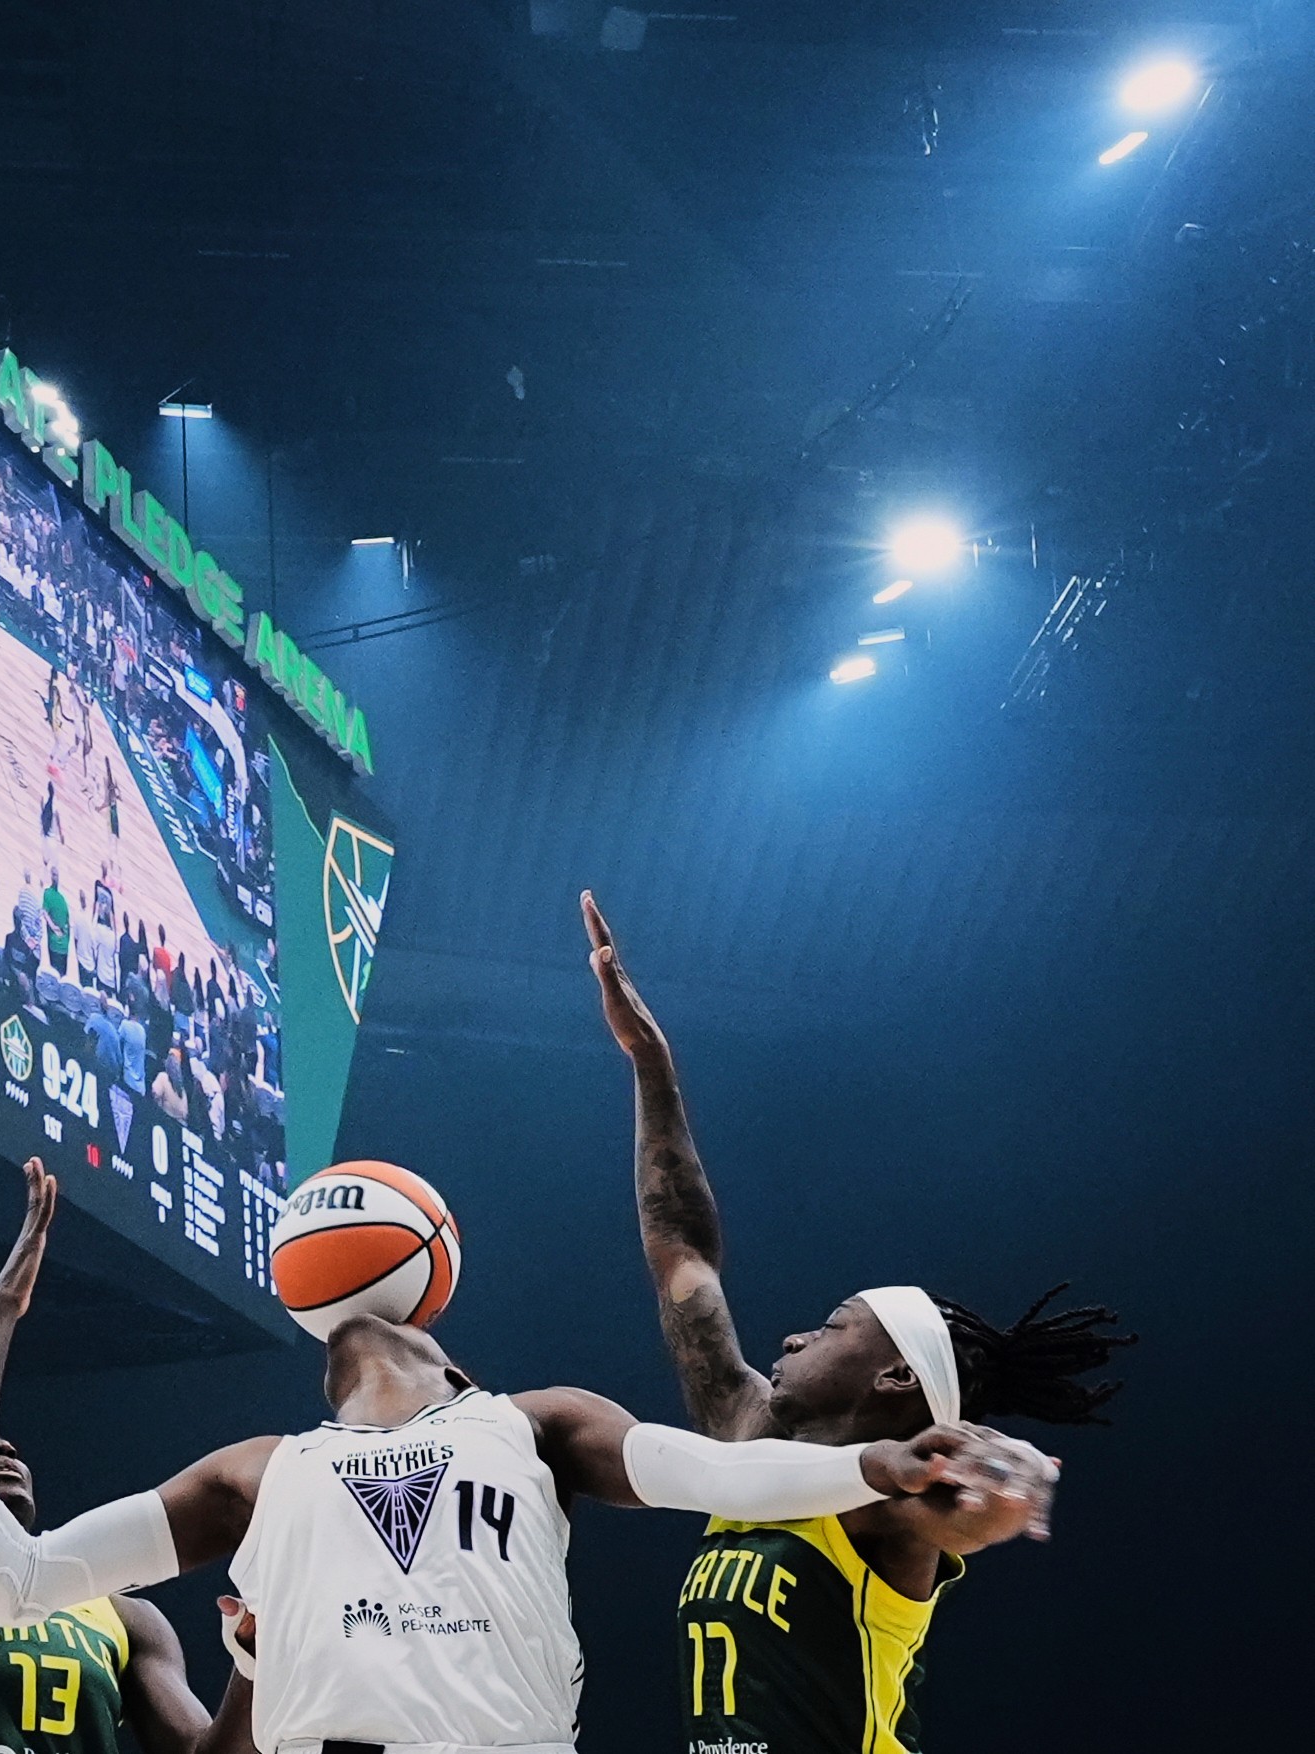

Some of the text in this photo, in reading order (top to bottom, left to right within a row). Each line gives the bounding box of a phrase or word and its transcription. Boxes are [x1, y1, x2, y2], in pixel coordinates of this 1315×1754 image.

[84, 440, 245, 648] PLEDGE
[245, 611, 375, 775] ARENA
[42, 1042, 100, 1128] 9:24
[152, 1125, 168, 1175] 0
[281, 1185, 366, 1219] Wils
[331, 1445, 454, 1477] VALKYRIES
[453, 1480, 515, 1562] 14
[398, 1603, 442, 1618] KASER
[678, 1549, 797, 1633] EATTLE
[9, 1651, 81, 1736] 13
[687, 1621, 738, 1716] 17
